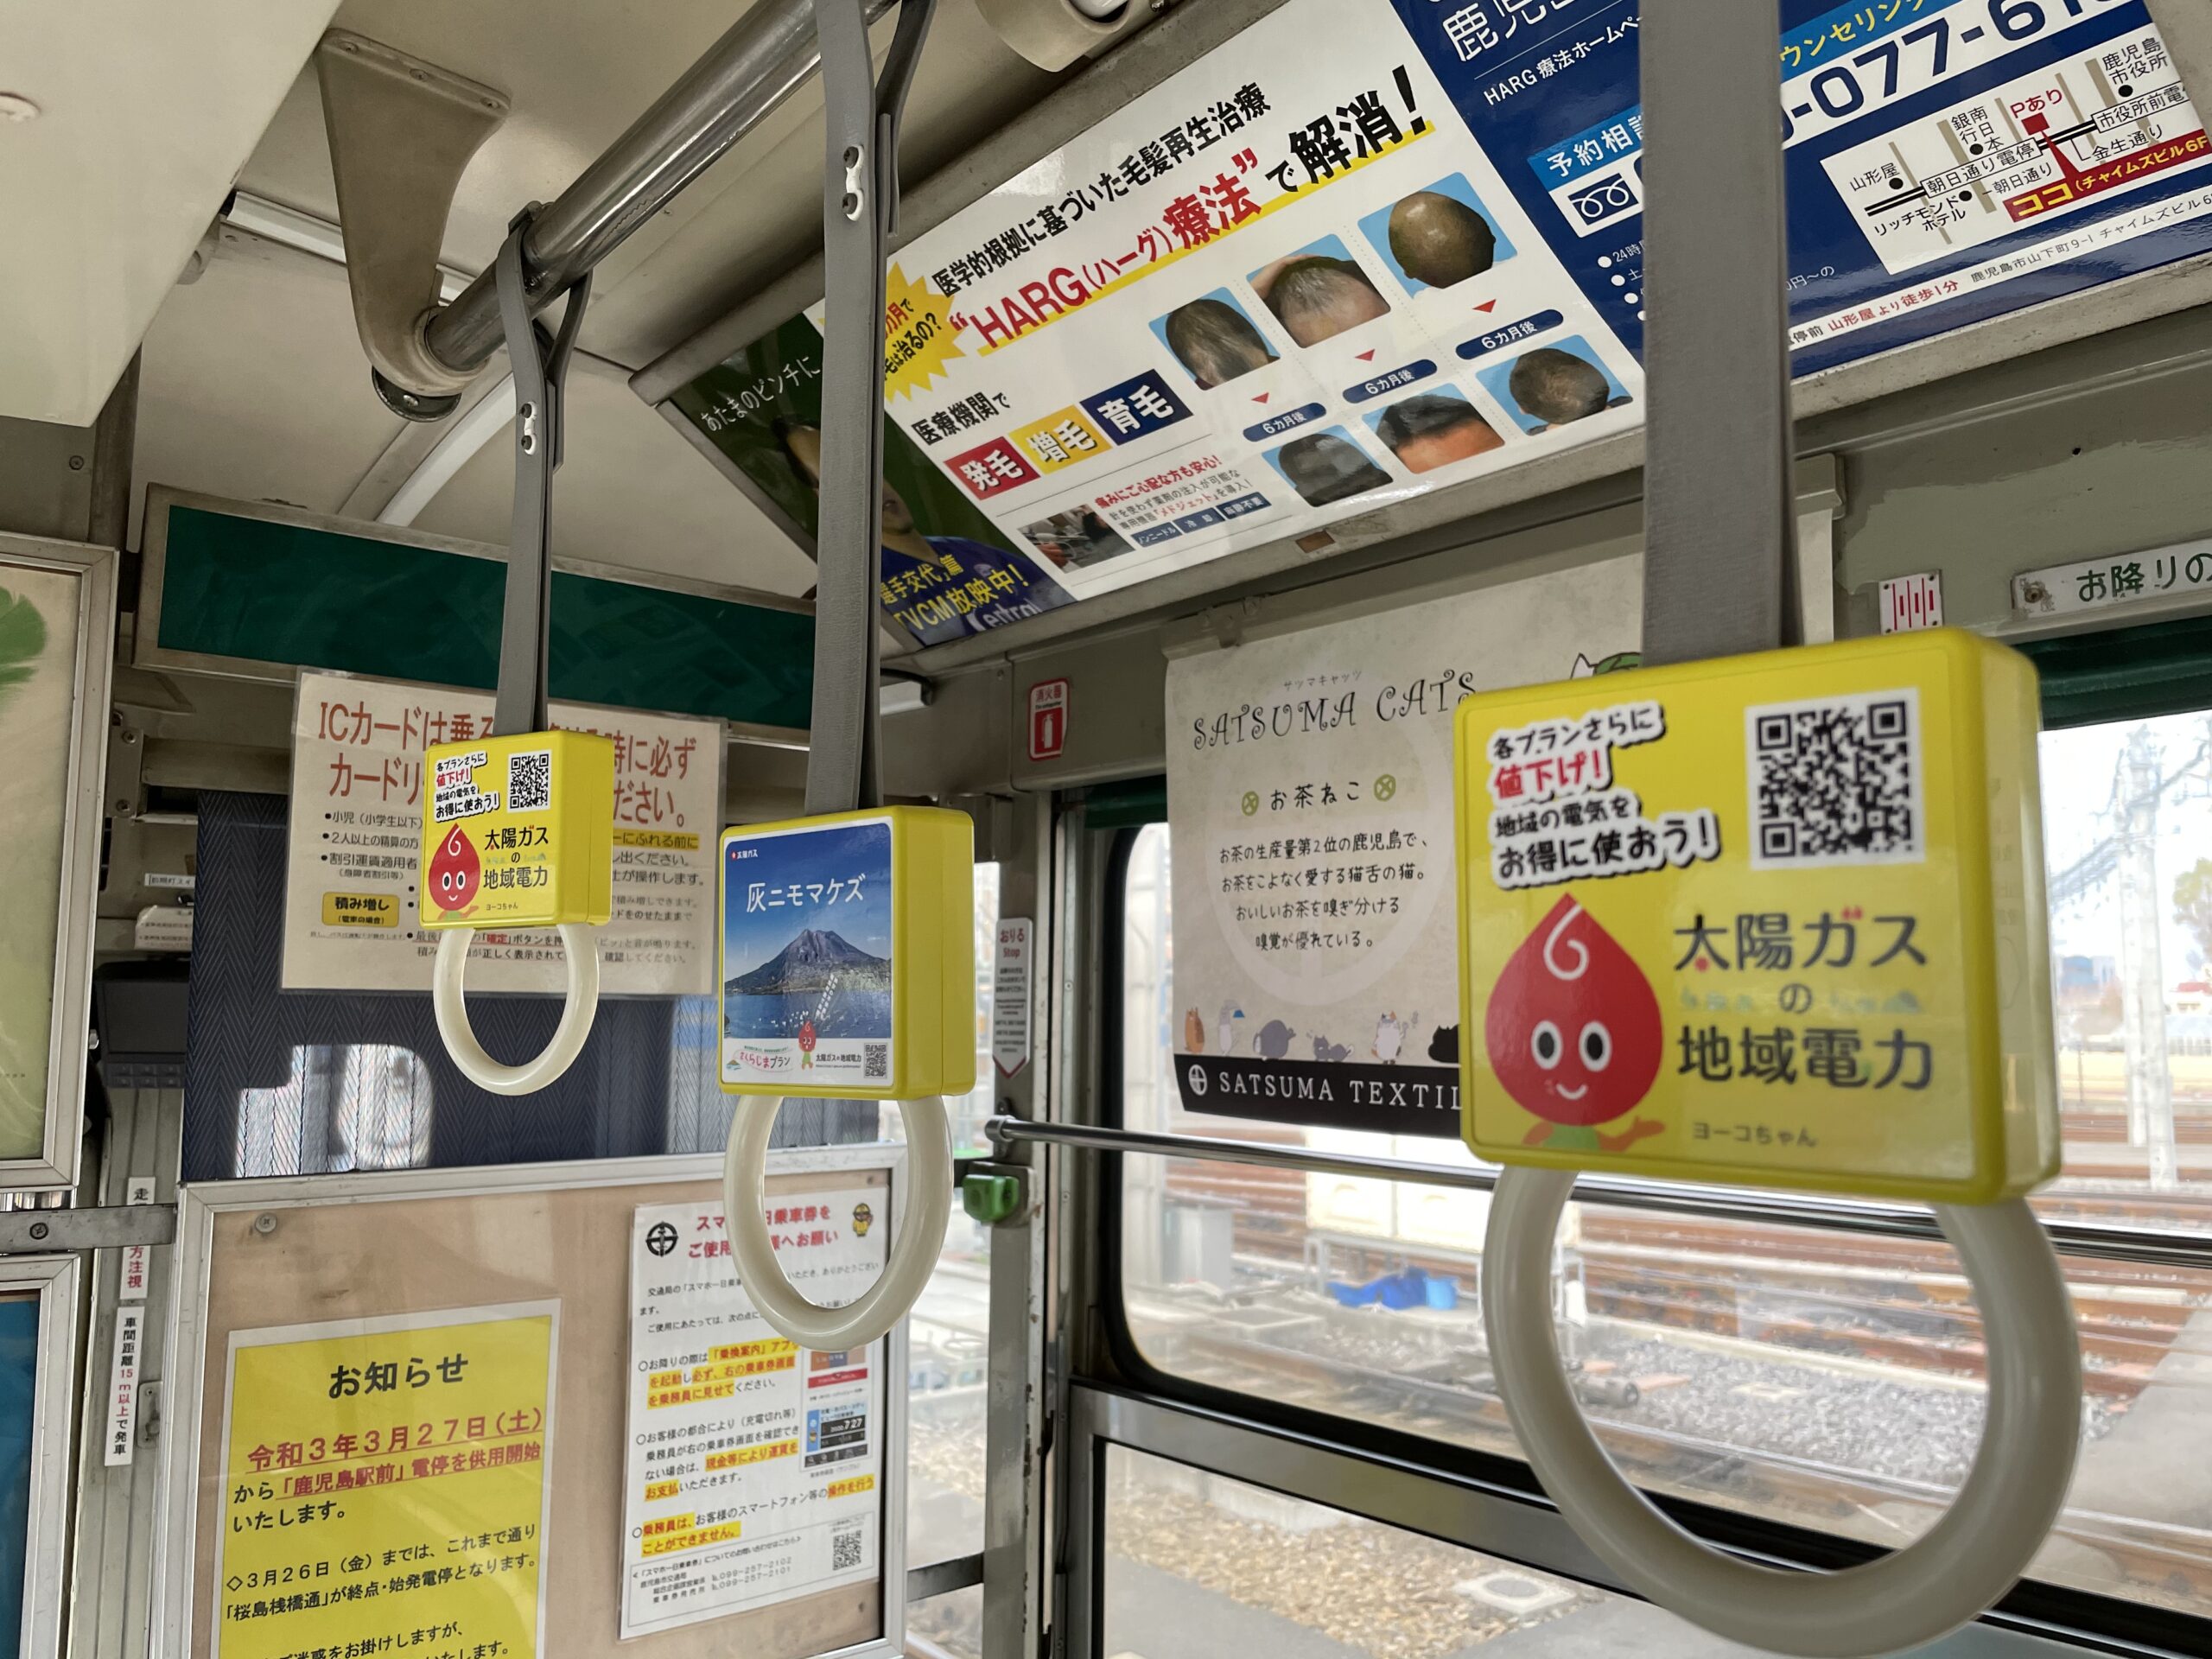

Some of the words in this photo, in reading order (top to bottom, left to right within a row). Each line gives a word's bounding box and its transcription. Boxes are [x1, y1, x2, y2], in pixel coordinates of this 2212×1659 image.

[1779, 0, 1924, 67] ウンセリン
[1484, 69, 1538, 105] HARG
[1535, 16, 1643, 79] 療法ホームペ
[2101, 37, 2161, 72] 鹿児島
[2108, 51, 2168, 85] 市役所
[2010, 88, 2063, 118] Pあり
[2097, 84, 2186, 128] 市役所前電
[2091, 124, 2164, 162] 金生通り
[1848, 162, 1900, 192] 山形屋
[1926, 142, 2035, 194] 朝日通り電停
[1993, 162, 2052, 195] 朝日通り
[932, 81, 1272, 298] 医学的根拠に基づいた毛髪再生治療
[2012, 182, 2074, 216] ココ
[1873, 194, 1960, 237] リッチモンド
[1923, 207, 1967, 232] ホテル
[1612, 240, 1645, 263] 24時
[1789, 326, 1823, 344] 停前
[701, 356, 821, 431] あたまのピンチに
[1097, 385, 1173, 434] 育毛
[911, 391, 1010, 446] 医療機関で
[1026, 419, 1098, 464] 増毛
[958, 449, 1024, 492] 発毛
[2075, 553, 2212, 603] お降りの
[1193, 692, 1357, 750] SATSUMA
[1376, 669, 1478, 722] CATS
[435, 786, 476, 802] 地域の電気を
[1269, 782, 1361, 811] お茶ねこ
[1496, 798, 1631, 837] 地域の電気を
[485, 825, 549, 851] 太陽ガス
[1219, 829, 1427, 865] お茶の生産量第2位の鹿児島で、
[512, 852, 520, 863] の
[484, 865, 548, 889] 地域電力
[747, 873, 866, 913] 灰ニモマケズ
[1222, 862, 1425, 893] お茶をこよなく愛する猫舌の猫。
[335, 897, 390, 911] 積み増し
[486, 902, 518, 911] ヨーコちゃん
[612, 910, 693, 920] ドをのせたままで
[1236, 897, 1400, 921] おいしいお茶を嗅ぎ分ける
[1000, 928, 1025, 943] おりる
[1255, 931, 1374, 952] 嗅覚が優れている。
[1673, 906, 1928, 972] 太陽ガス
[1778, 983, 1812, 1014] の
[1677, 1025, 1933, 1092] 地域電力
[1219, 1071, 1335, 1103] SATSUMA
[1692, 1122, 1820, 1149] ヨーコちゃん
[327, 1353, 468, 1399] お知らせ
[232, 1501, 346, 1533] いたします。
